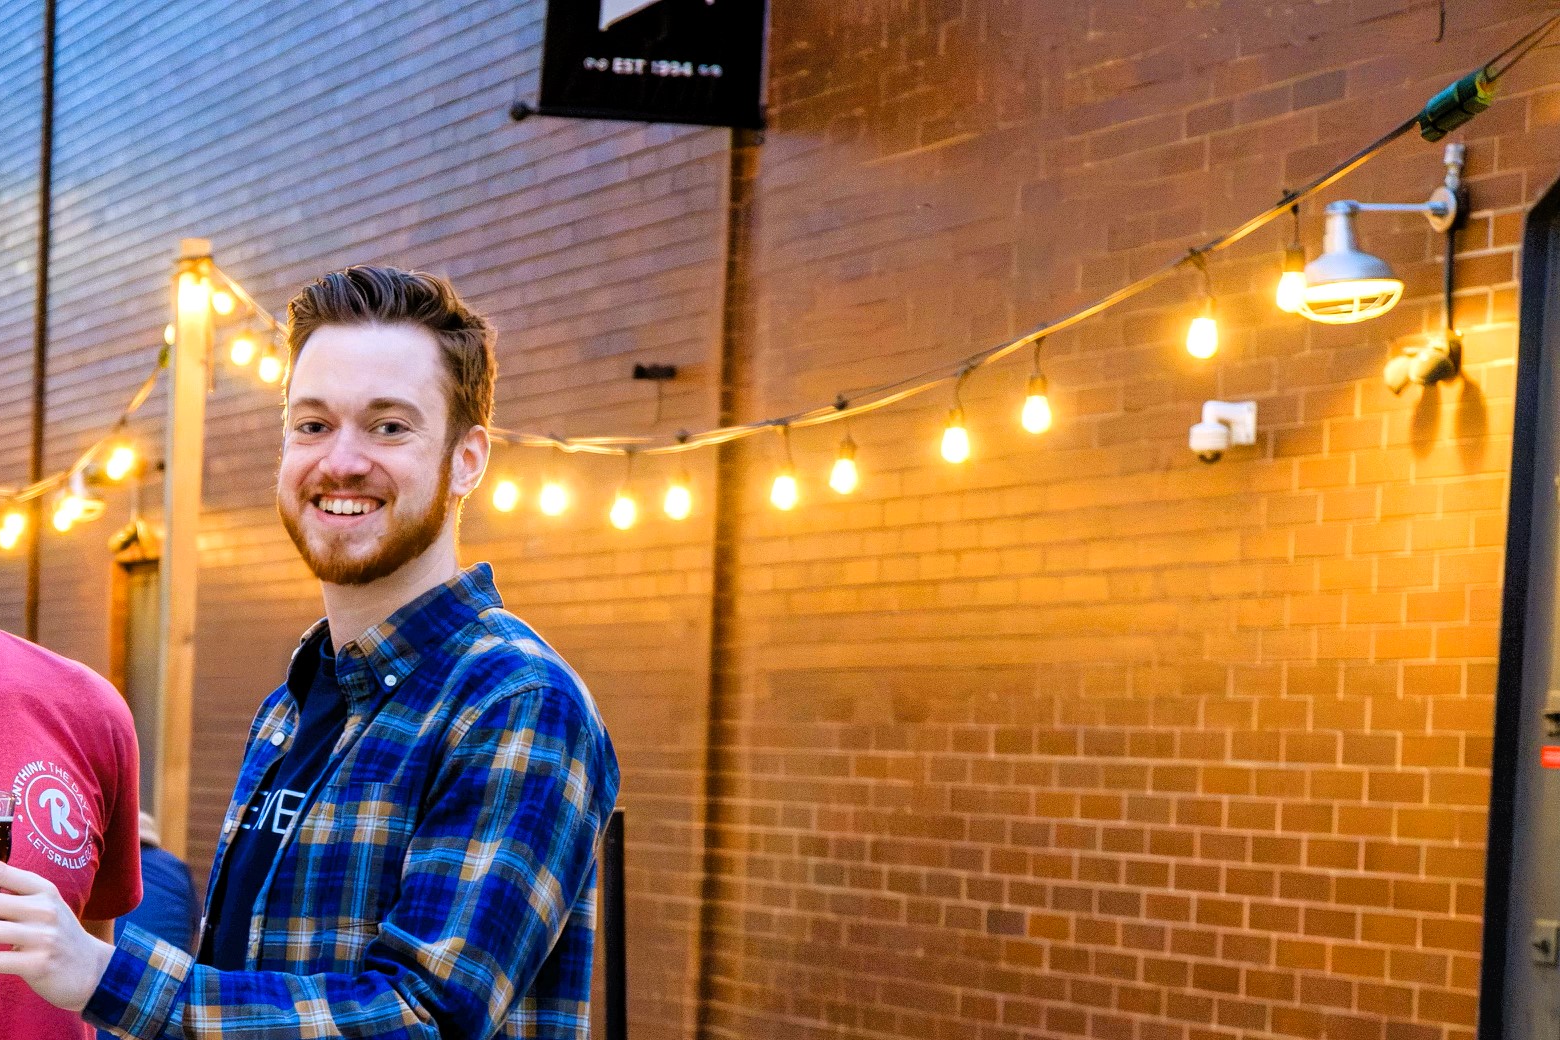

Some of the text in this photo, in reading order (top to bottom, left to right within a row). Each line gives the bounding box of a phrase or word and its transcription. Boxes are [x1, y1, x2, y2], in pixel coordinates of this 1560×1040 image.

[612, 57, 647, 75] EST
[12, 760, 90, 812] UNTHINK THE DAY
[38, 788, 80, 840] R
